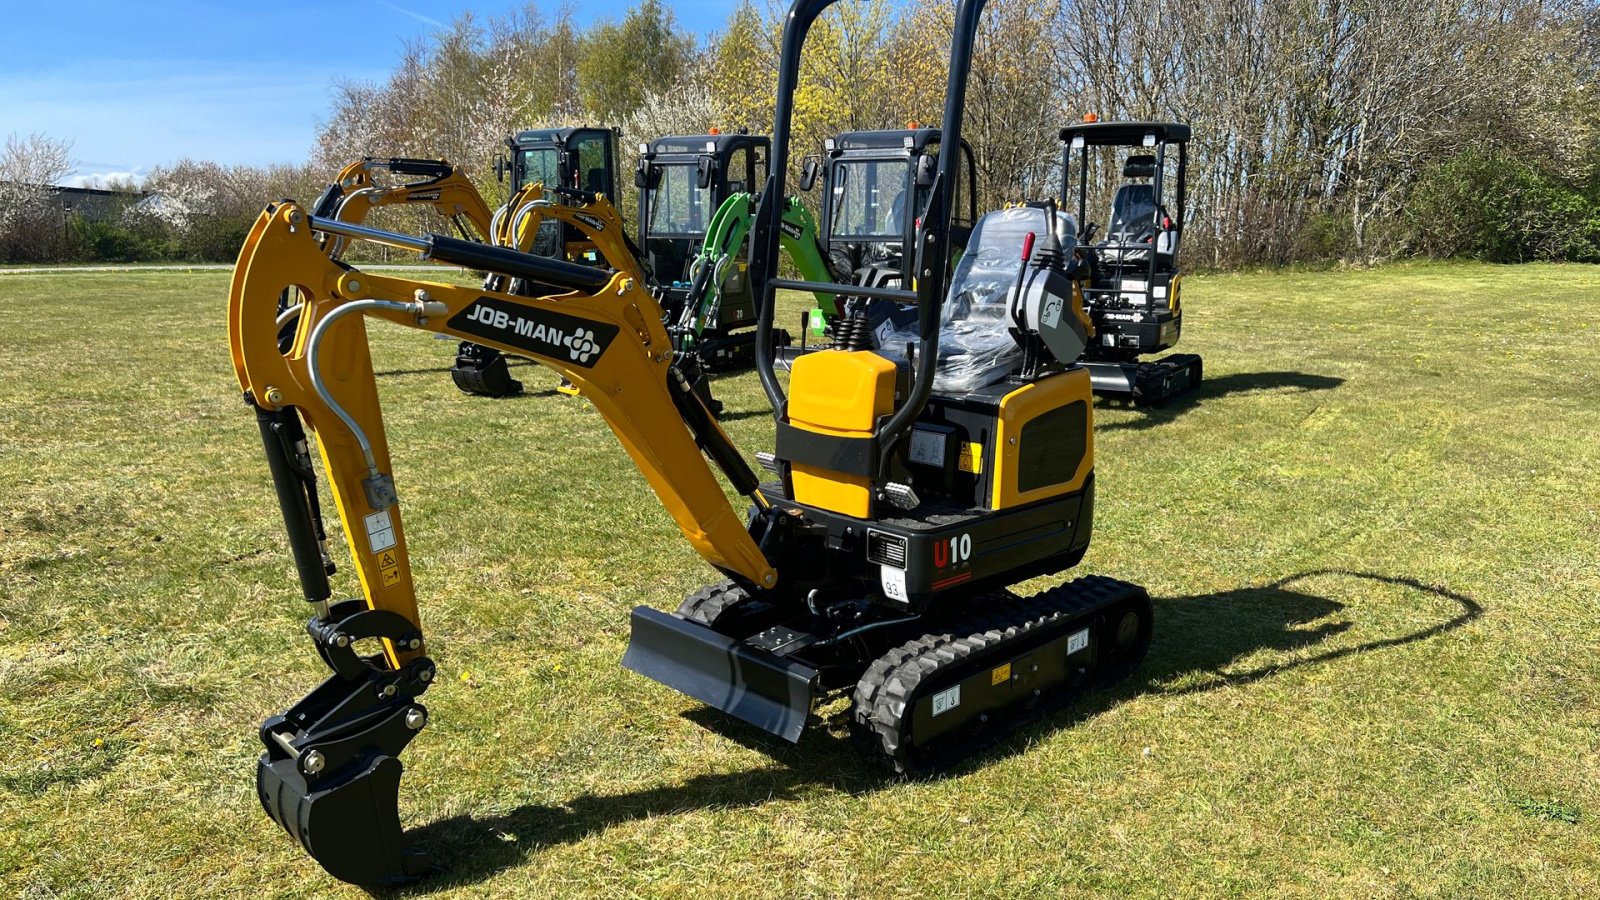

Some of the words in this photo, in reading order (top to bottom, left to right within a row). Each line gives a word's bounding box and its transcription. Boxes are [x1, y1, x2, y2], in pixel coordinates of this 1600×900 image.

[467, 304, 563, 347] JOB-MAN
[935, 533, 971, 567] U10
[886, 581, 898, 596] 93
